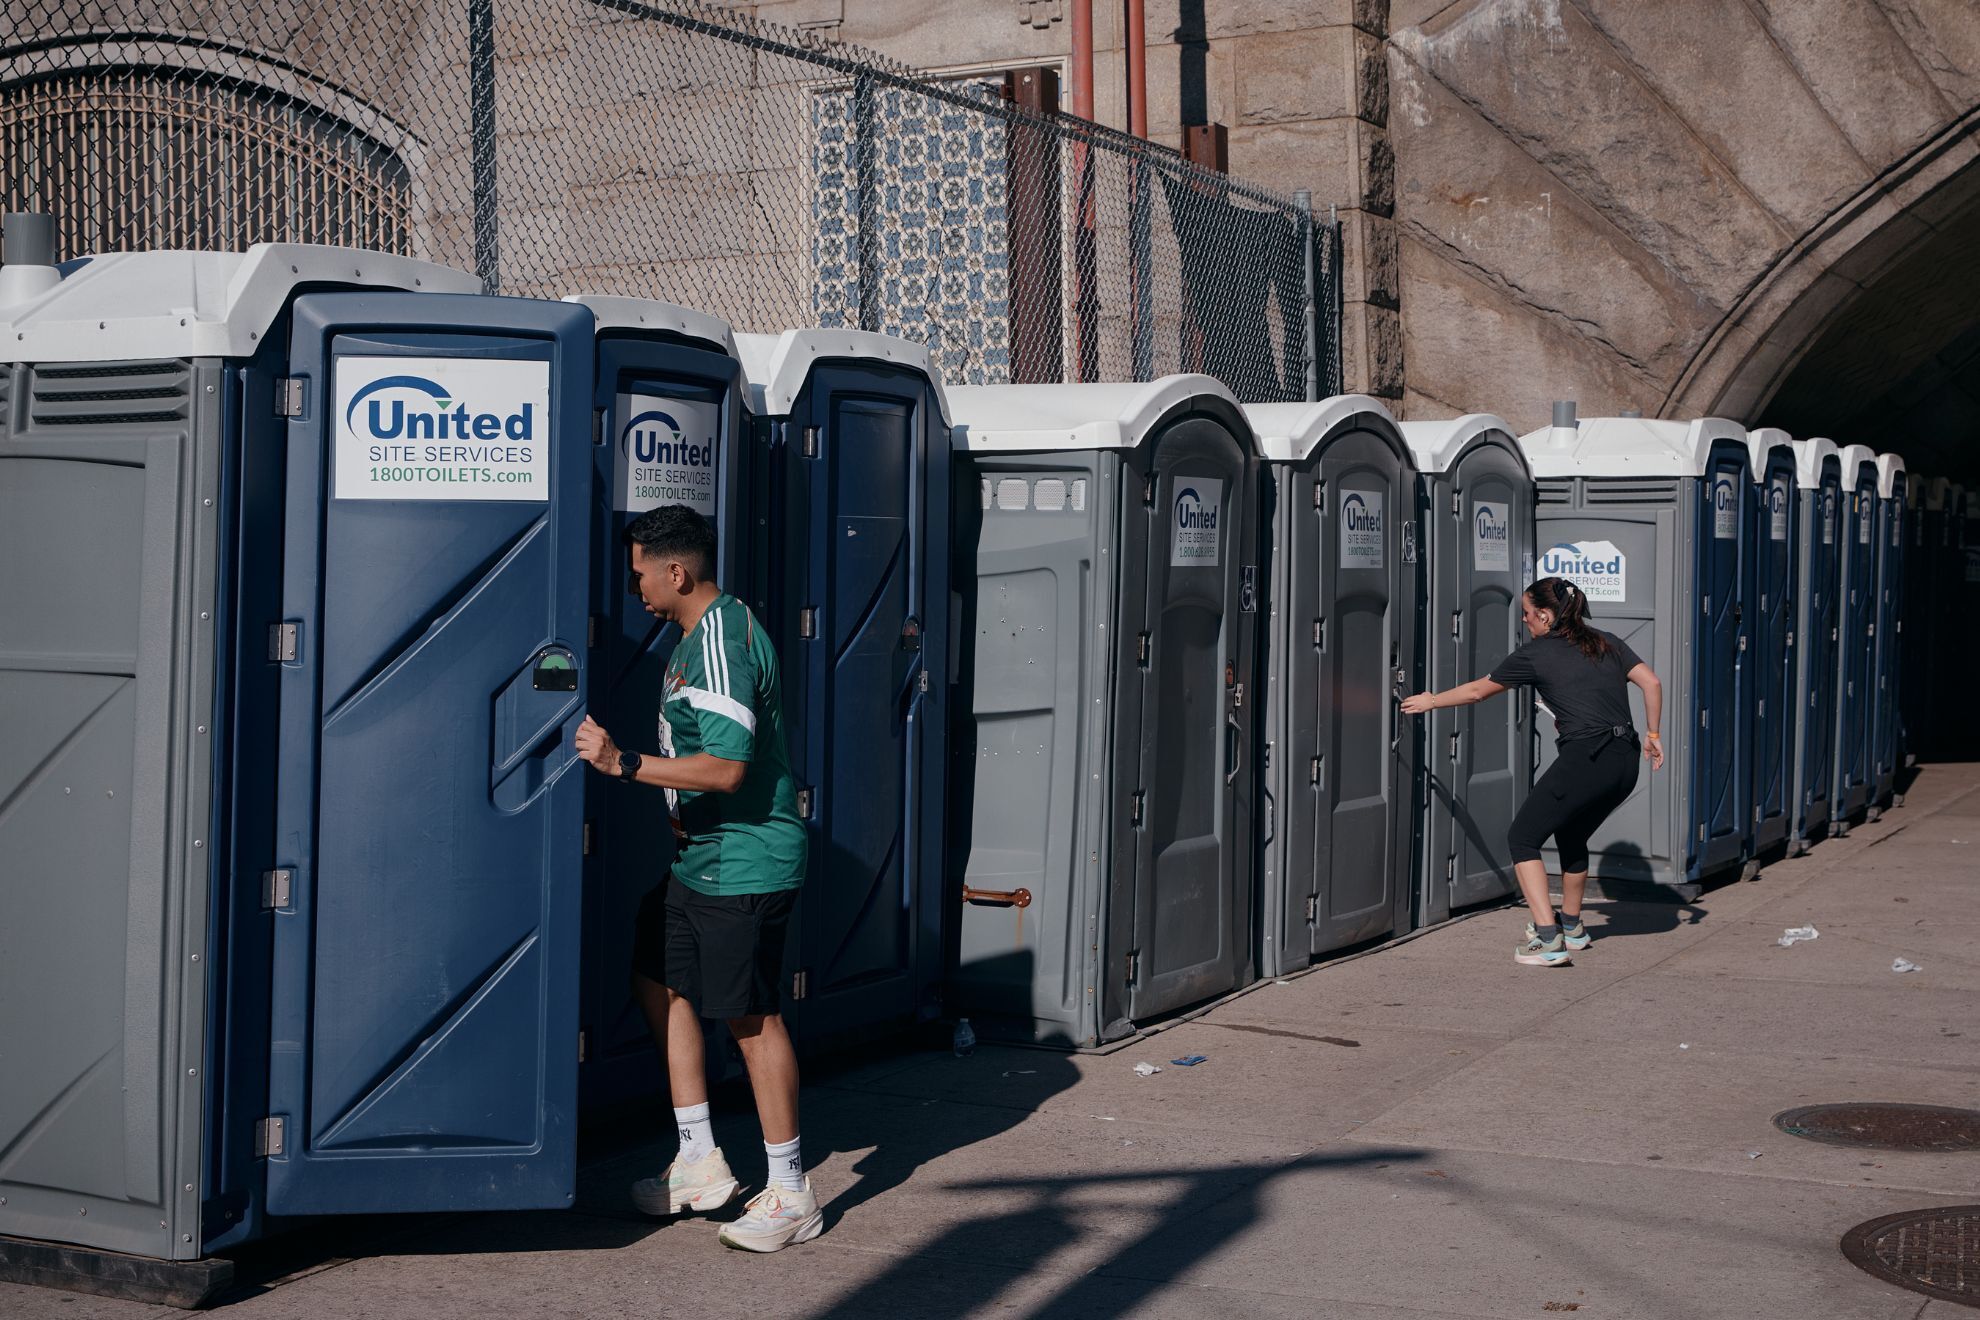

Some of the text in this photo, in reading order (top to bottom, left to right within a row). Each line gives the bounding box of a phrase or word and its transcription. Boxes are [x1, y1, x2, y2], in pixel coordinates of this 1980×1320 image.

[368, 400, 532, 441] United
[369, 446, 533, 463] SITE SERVICES
[635, 429, 712, 467] United
[369, 467, 533, 483] 1800TOILETS.com
[635, 467, 711, 486] SITE SERVICES
[635, 485, 711, 502] 1800TOILETS.com
[1179, 503, 1217, 529] United
[1347, 507, 1381, 532] United
[1179, 532, 1192, 543] SITE
[1478, 518, 1506, 540] United
[1347, 534, 1359, 545] SITE
[1543, 554, 1620, 575] United
[1568, 576, 1620, 586] SERVICES
